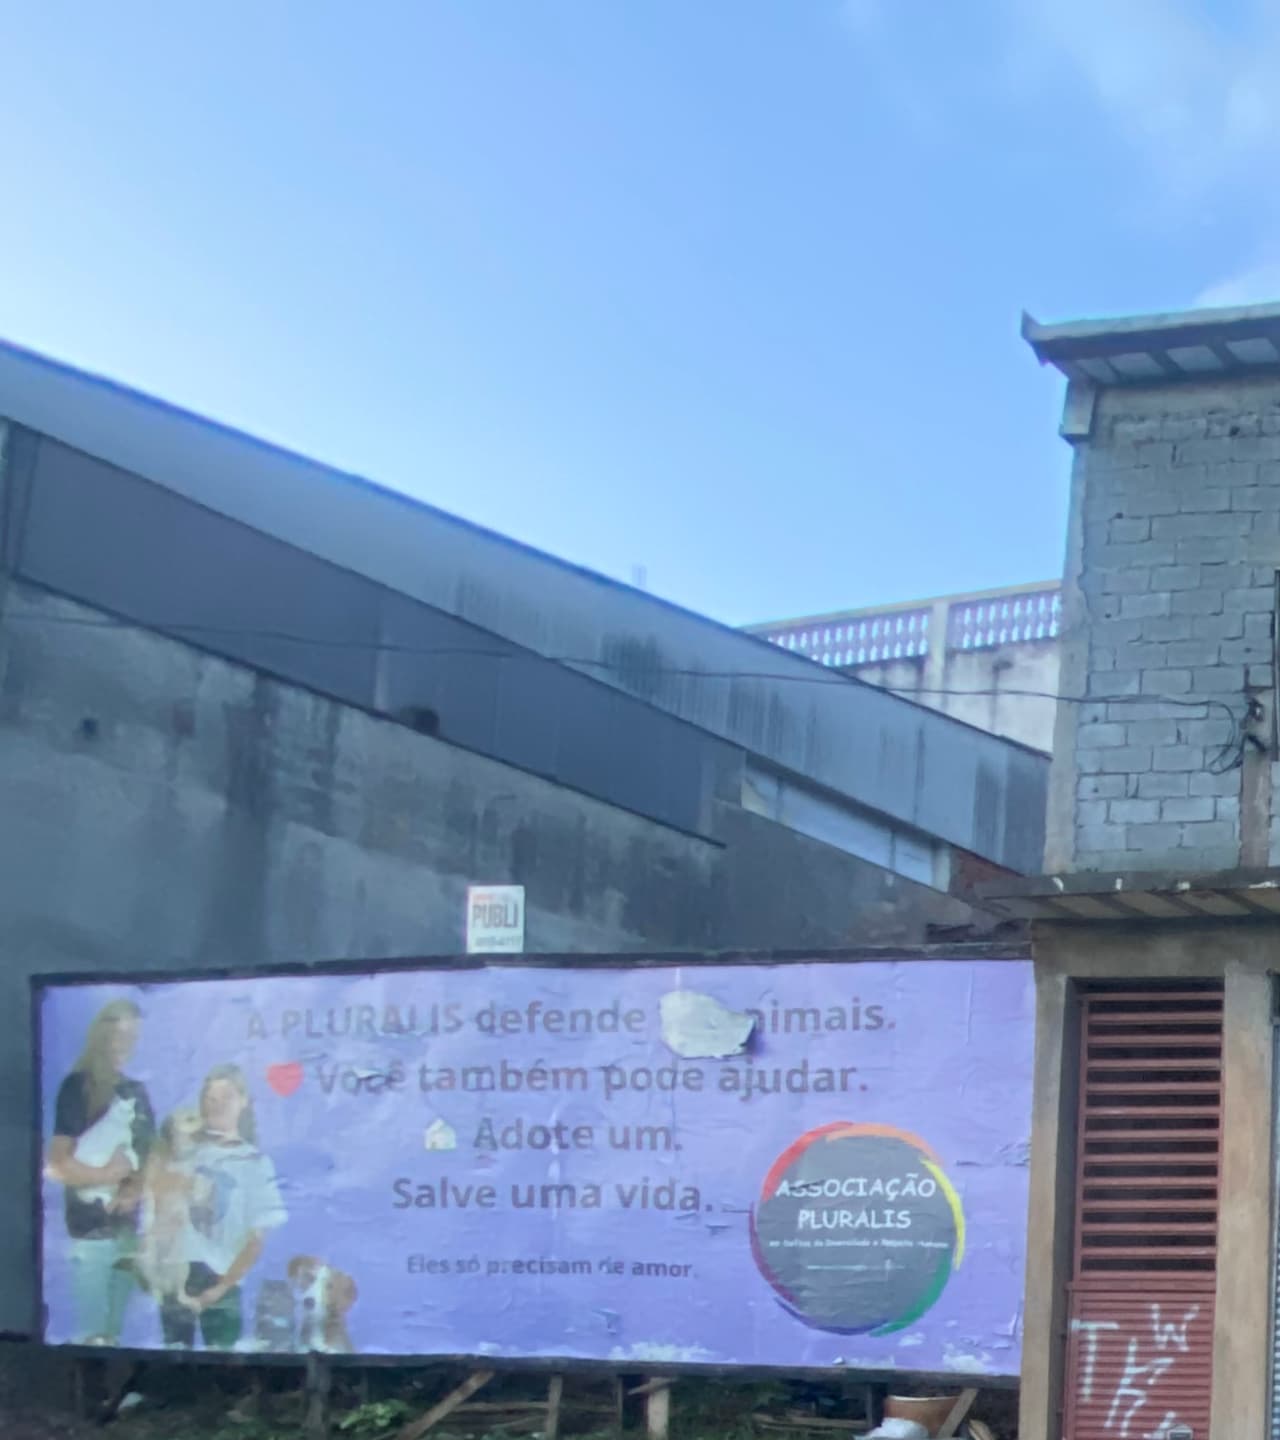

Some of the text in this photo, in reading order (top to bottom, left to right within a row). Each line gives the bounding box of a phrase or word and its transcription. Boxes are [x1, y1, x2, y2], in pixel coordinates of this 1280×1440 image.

[472, 903, 518, 929] PUBLI
[476, 1000, 646, 1034] defende
[744, 998, 896, 1033] nimais.
[316, 1052, 868, 1102] Você também pode ajudar.
[473, 1117, 682, 1151] Adote um.
[392, 1176, 713, 1213] Salve uma vida.
[775, 1173, 937, 1202] ASSOCIAÇÃO
[798, 1209, 912, 1231] PLURALIS
[406, 1254, 449, 1275] Eles
[486, 1256, 592, 1278] precisam
